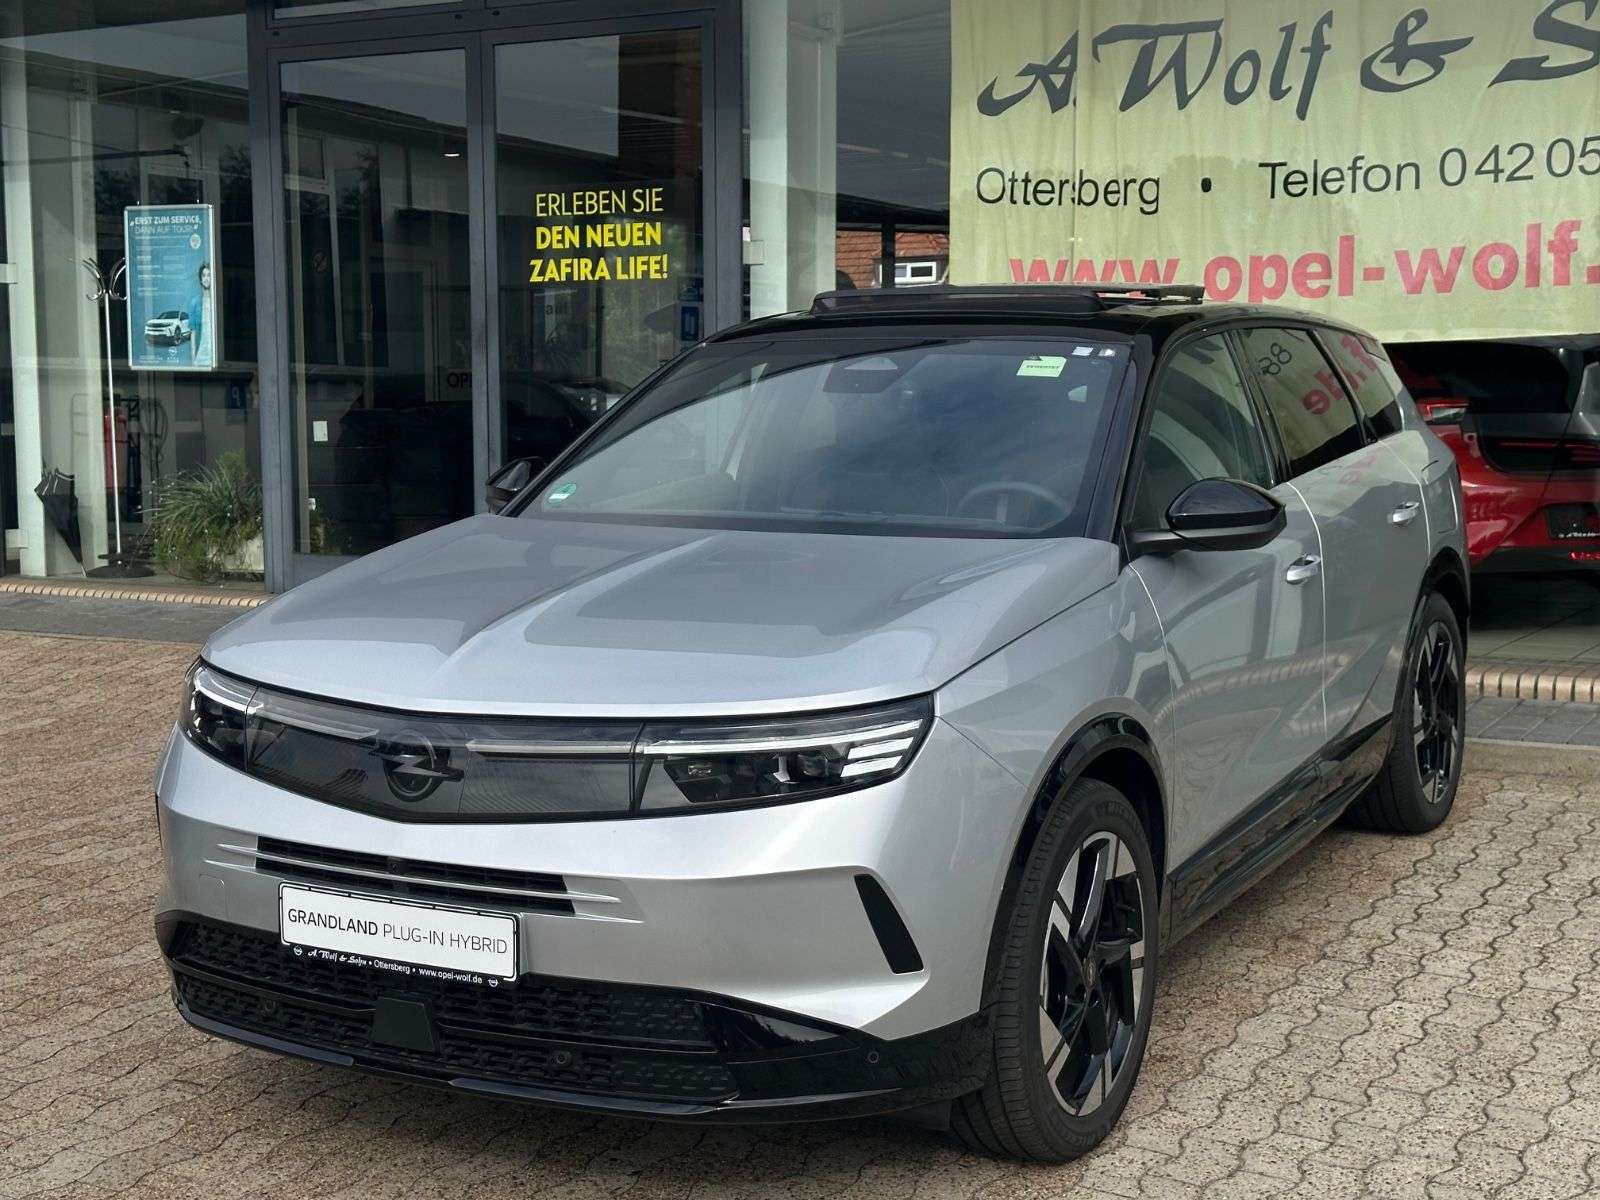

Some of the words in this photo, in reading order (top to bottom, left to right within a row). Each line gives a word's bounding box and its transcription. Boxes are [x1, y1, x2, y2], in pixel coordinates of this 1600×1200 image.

[1092, 9, 1334, 121] Wolf
[1360, 8, 1474, 93] &
[1258, 155, 1421, 199] Telefon
[536, 189, 626, 217] ERLEBEN
[632, 187, 664, 213] SIE
[536, 225, 580, 250] DEN
[586, 222, 662, 248] NEUEN
[529, 257, 612, 283] ZAFIRA
[616, 253, 668, 280] LIFE!
[288, 908, 379, 936] GRANDLAND
[383, 923, 444, 946] PLUG-IN
[450, 932, 508, 954] HYBRID
[373, 959, 410, 975] Ottersberg
[419, 967, 483, 984] www.opel-wolf.de
